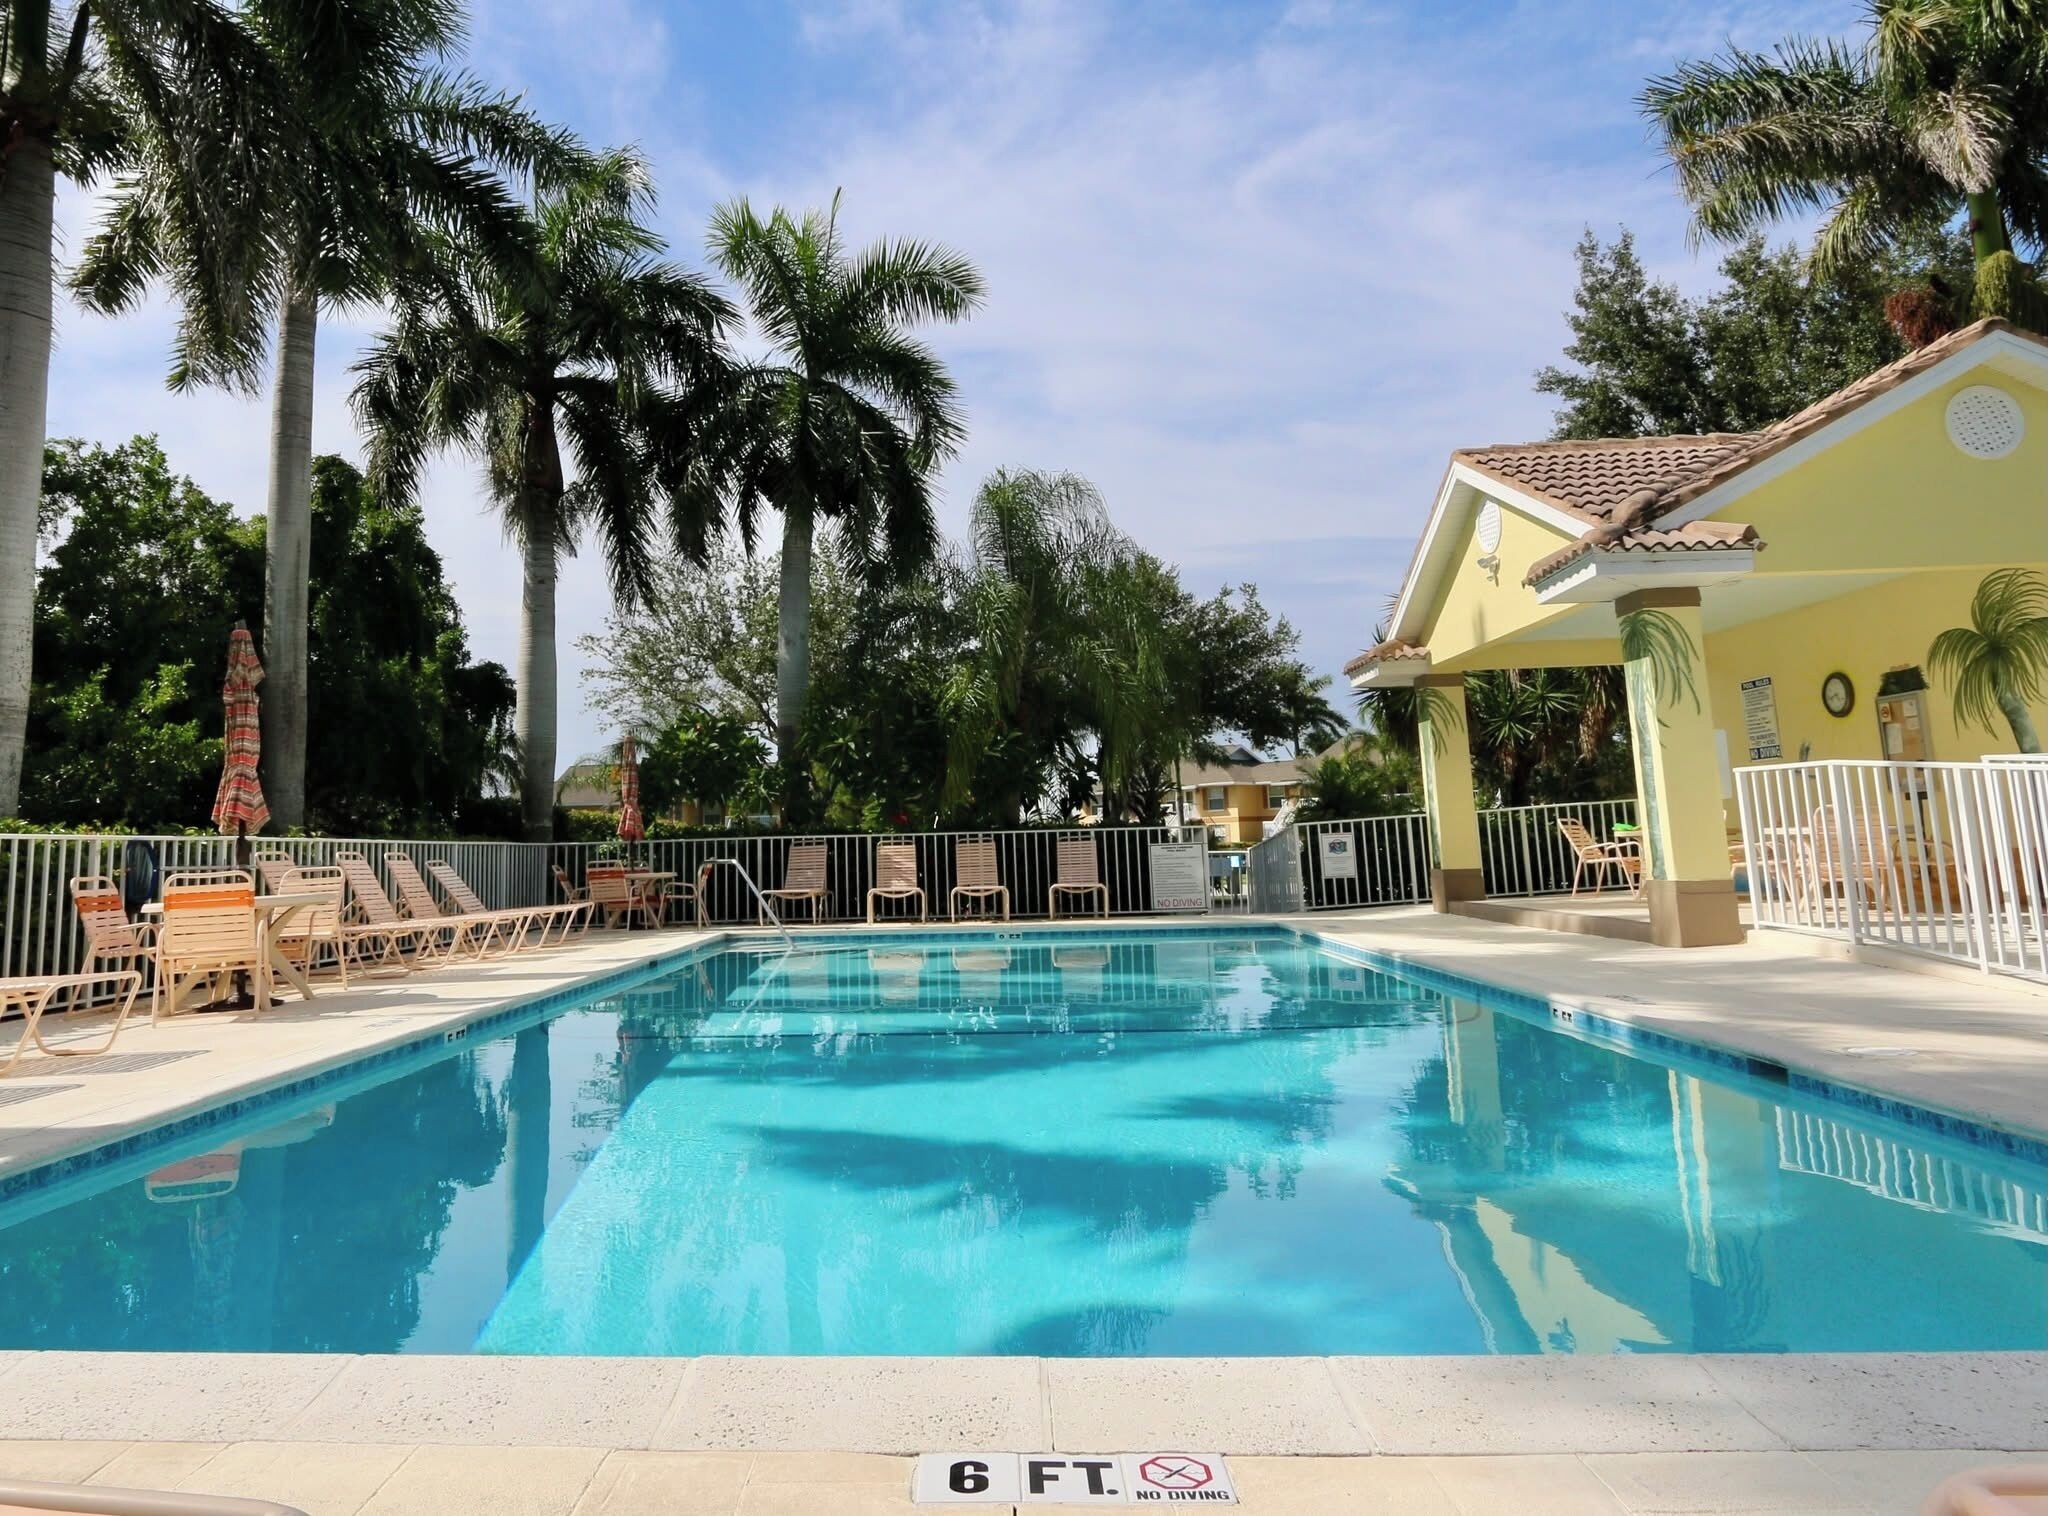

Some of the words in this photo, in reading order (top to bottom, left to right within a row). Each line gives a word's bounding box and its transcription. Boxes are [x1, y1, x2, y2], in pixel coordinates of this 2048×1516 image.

[1743, 681, 1754, 689] POOL
[1755, 678, 1769, 686] RULES
[1751, 748, 1758, 759] NO
[1759, 746, 1780, 758] DIVING
[1157, 899, 1170, 907] NO
[1173, 898, 1202, 907] DIVING
[949, 1460, 989, 1494] 6
[1028, 1460, 1119, 1495] FT.
[1136, 1490, 1161, 1501] NO
[1168, 1490, 1230, 1501] DIVING
